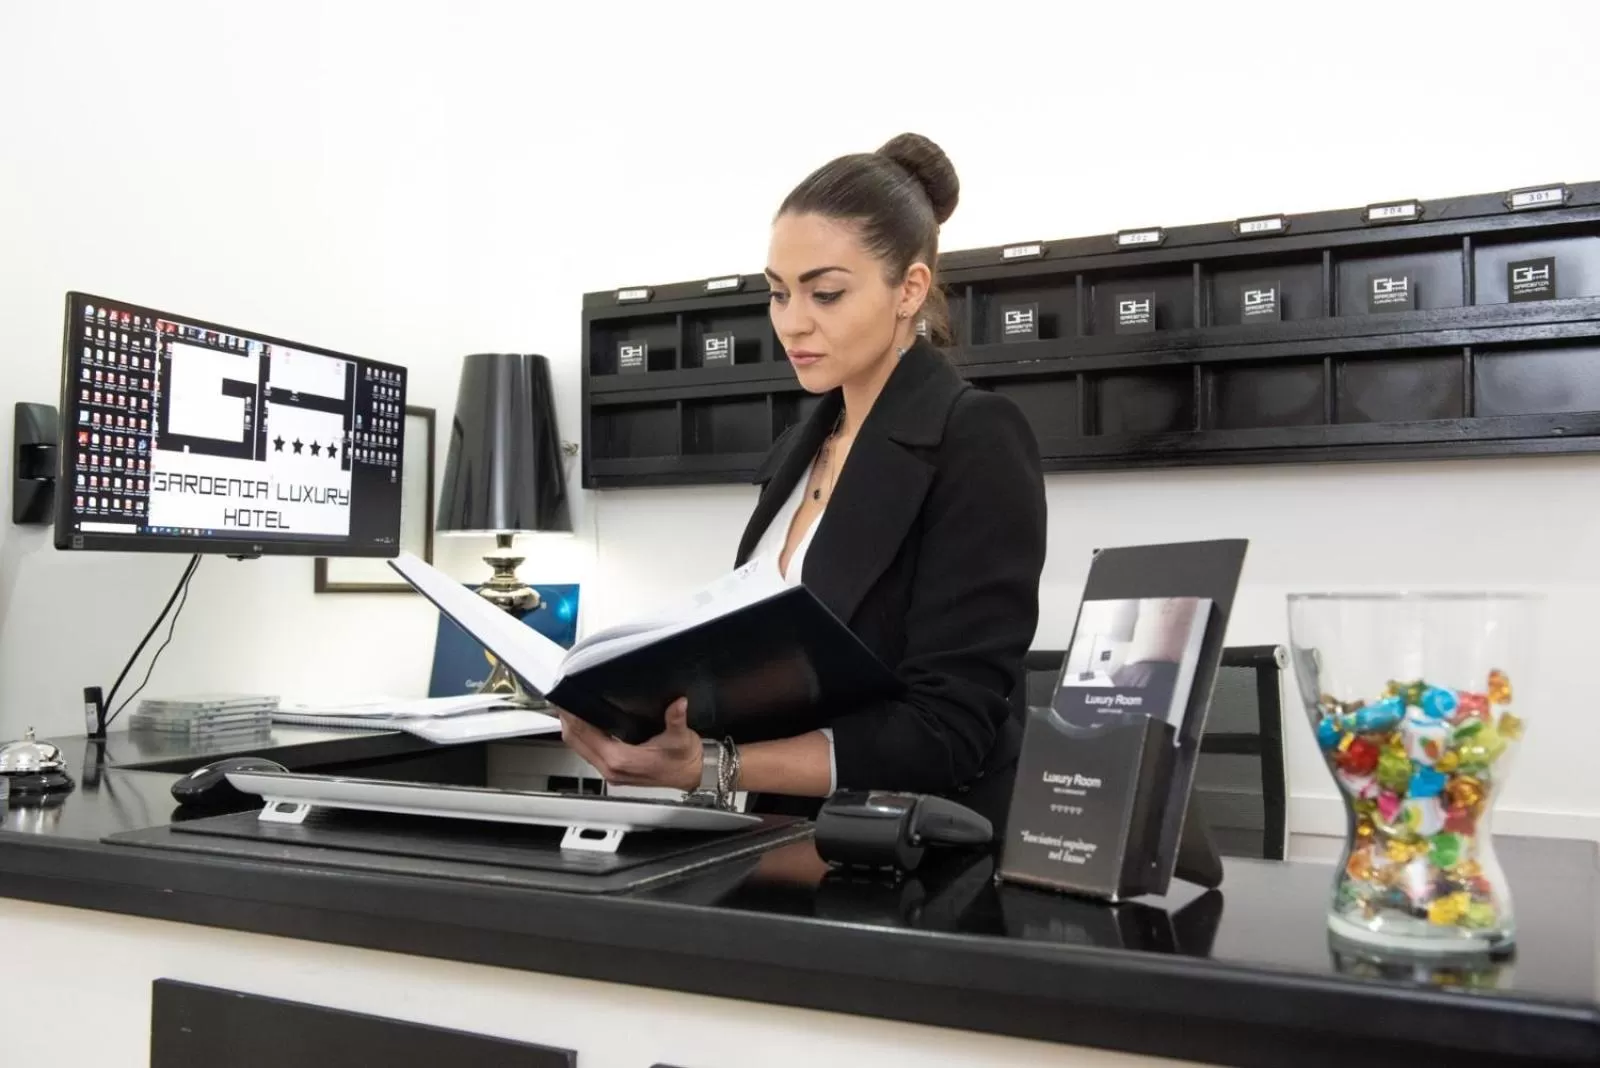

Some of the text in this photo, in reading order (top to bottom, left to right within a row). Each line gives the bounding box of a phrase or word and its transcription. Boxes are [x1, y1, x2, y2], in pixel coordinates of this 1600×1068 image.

[1513, 264, 1549, 282] GH
[1373, 276, 1408, 292] GH
[1244, 288, 1275, 304] GH
[1119, 299, 1150, 314] GH
[1005, 309, 1032, 323] GH
[153, 471, 350, 506] GARDENIA LUXURY
[224, 508, 290, 529] HOTEL
[1085, 693, 1143, 707] Luxury Room
[1043, 771, 1101, 787] Luxury Room
